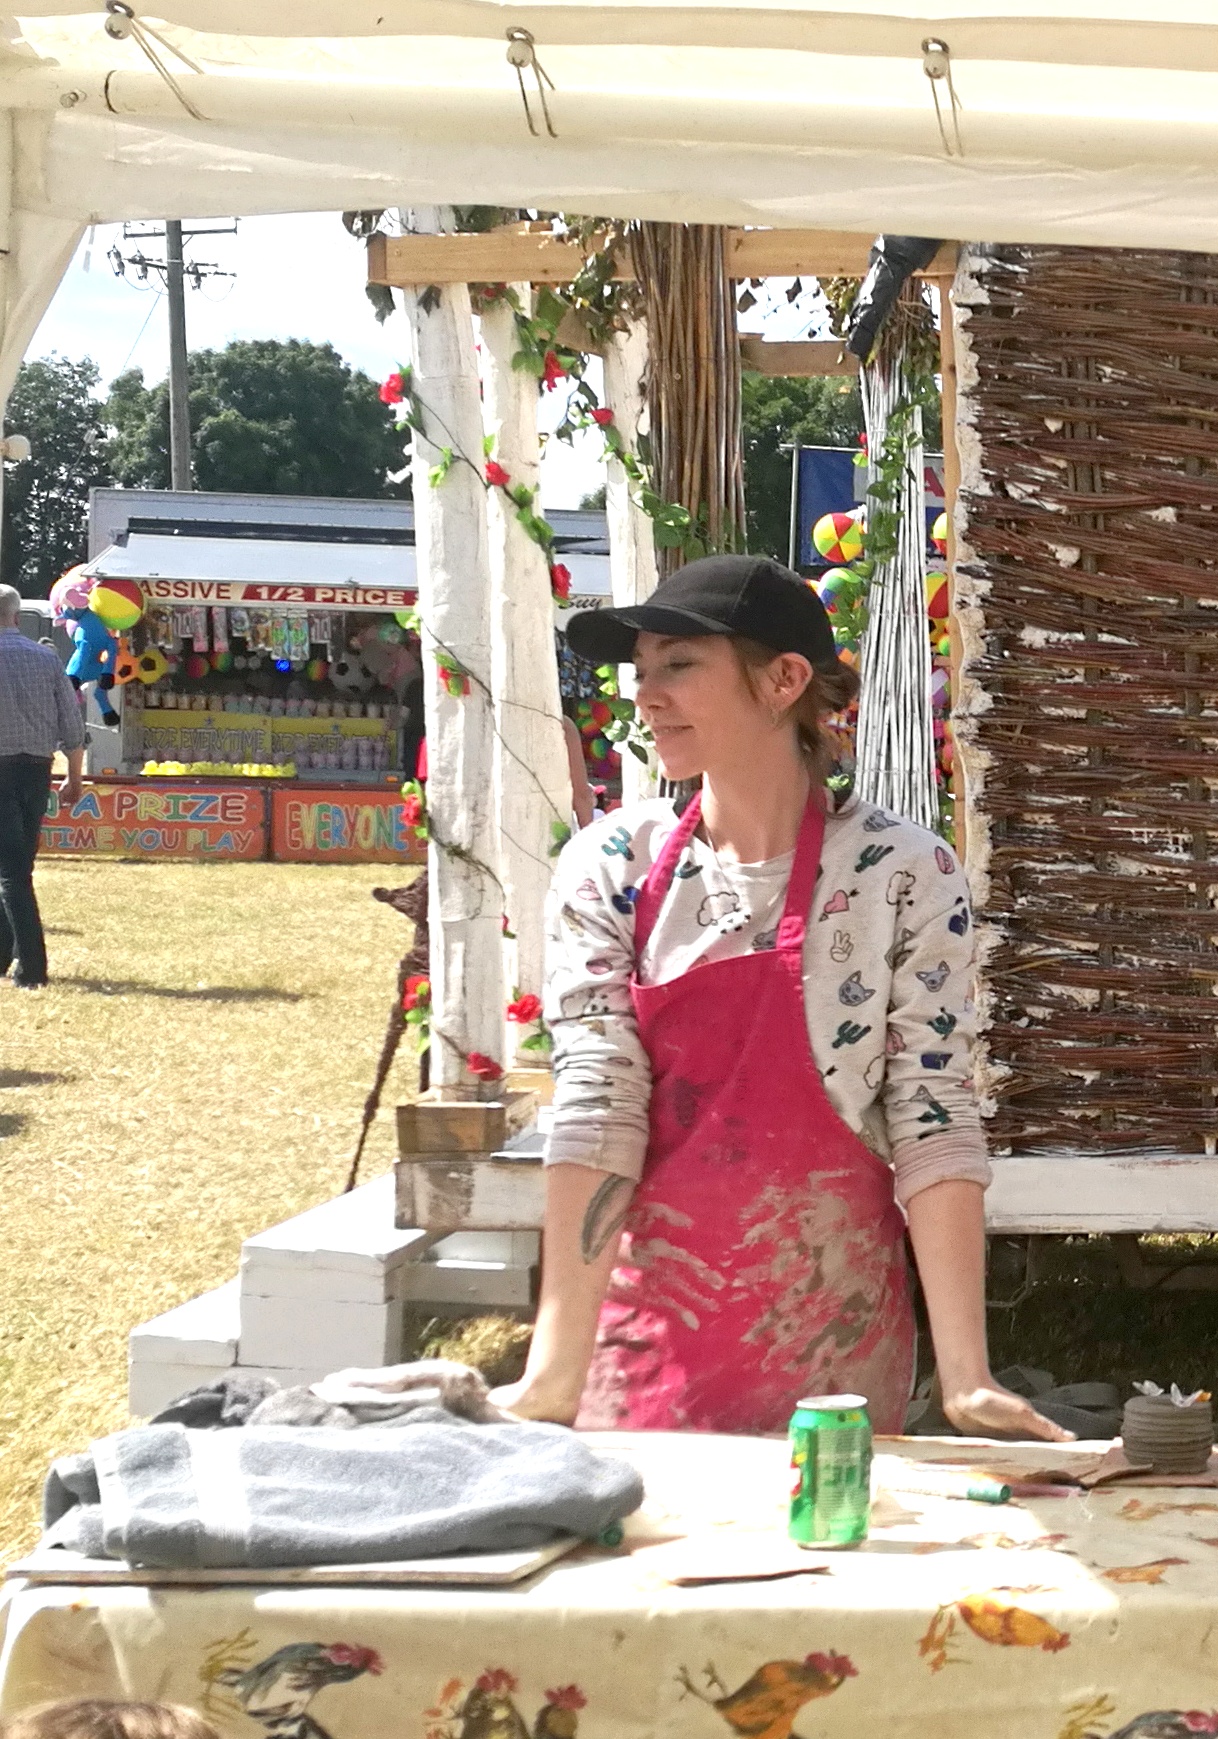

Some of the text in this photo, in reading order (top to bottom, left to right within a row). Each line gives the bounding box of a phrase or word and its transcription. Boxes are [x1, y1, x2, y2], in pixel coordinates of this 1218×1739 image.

[140, 580, 231, 600] ASSIVE
[256, 586, 305, 601] 1/2
[314, 588, 405, 606] PRICE
[71, 791, 103, 819] A
[115, 791, 247, 824] PRIZE
[121, 827, 180, 851] YOU
[186, 828, 253, 853] PLAY
[286, 801, 409, 850] EVERYONE
